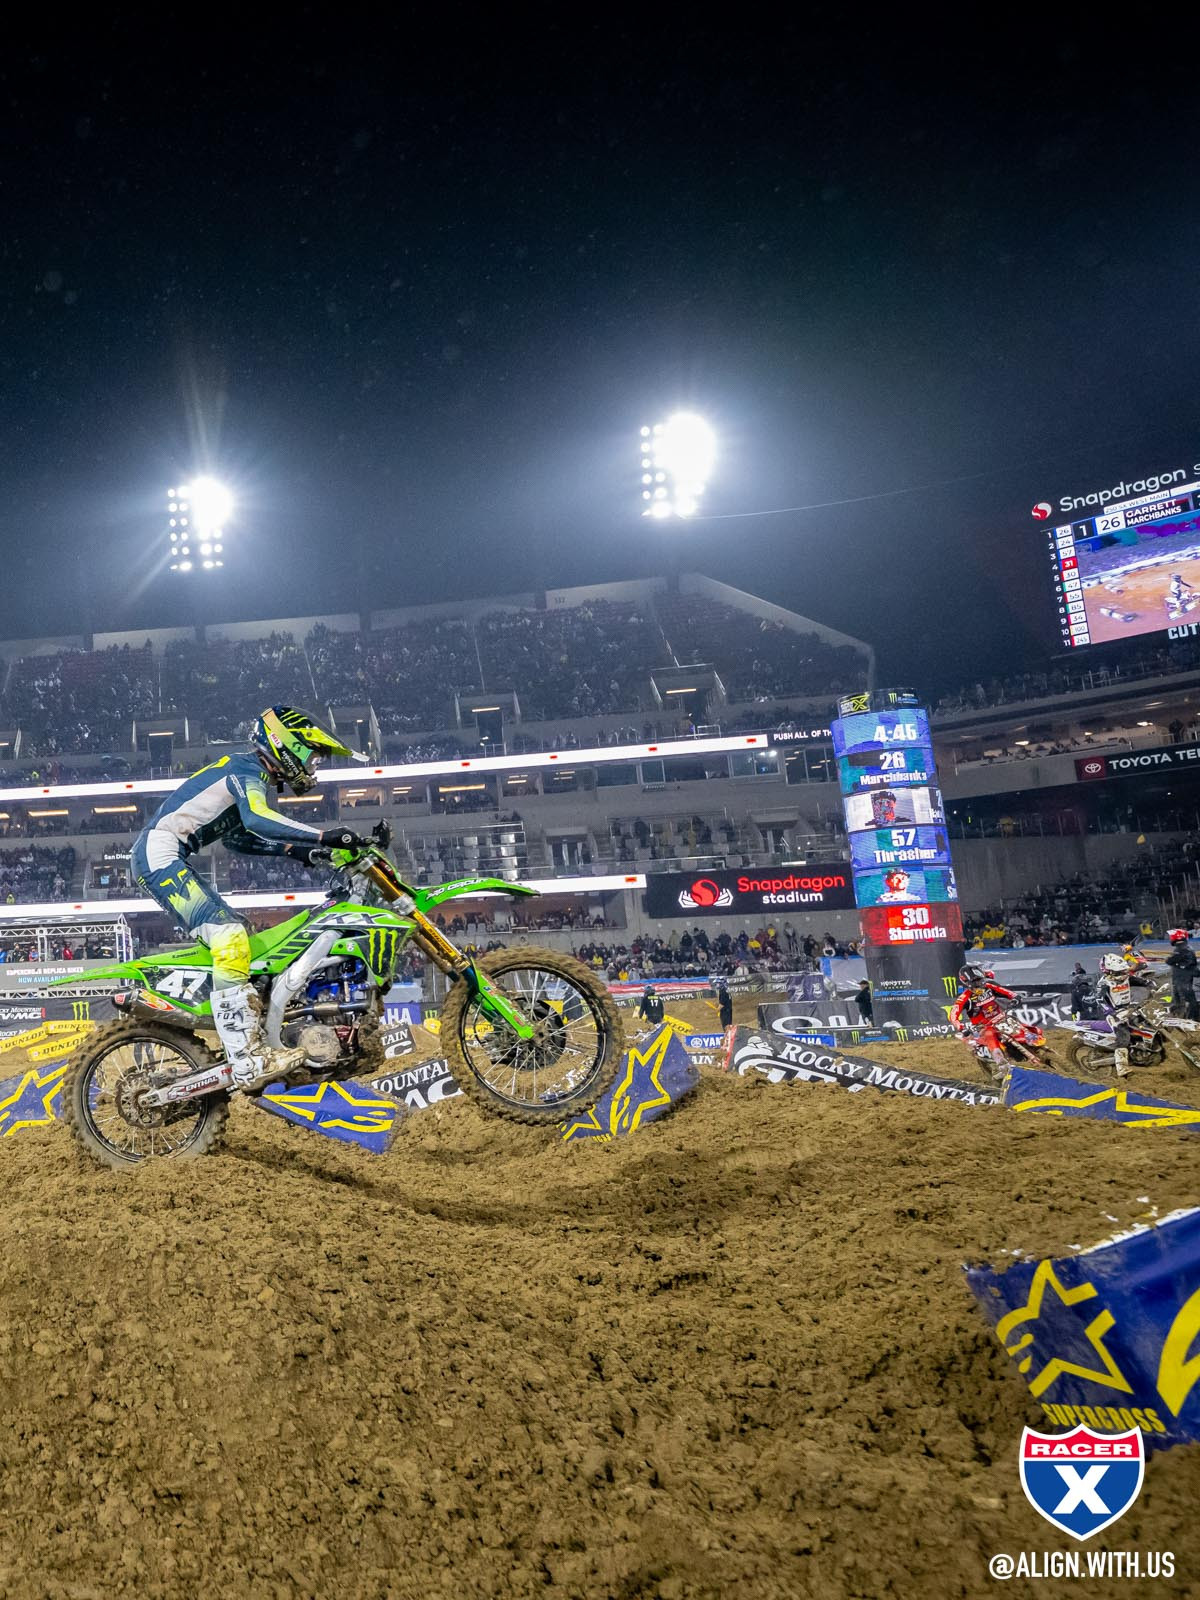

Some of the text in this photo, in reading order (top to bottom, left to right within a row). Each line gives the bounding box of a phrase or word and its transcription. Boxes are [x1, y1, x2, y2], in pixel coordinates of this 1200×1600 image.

[1060, 469, 1186, 512] Snapdragon
[1126, 500, 1176, 518] GARRETT
[1129, 498, 1148, 508] WEST
[1148, 492, 1169, 503] MAIN
[1127, 507, 1182, 526] MARCHBANKS
[1080, 517, 1121, 536] 1 26
[1065, 560, 1073, 568] 31
[1064, 639, 1071, 647] 11
[774, 732, 793, 741] PUSH
[794, 731, 809, 739] ALL
[880, 751, 906, 770] 26
[1109, 753, 1172, 770] TOYOTA
[891, 828, 916, 847] 57
[874, 846, 937, 863] Thrasher
[737, 875, 845, 894] Snapdragon
[763, 892, 823, 904] stadium
[902, 908, 929, 926] 30
[889, 926, 947, 941] Shimoda
[156, 970, 207, 1000] 47
[217, 1012, 236, 1020] FOX
[5, 1030, 46, 1048] DUNLOP
[778, 1042, 864, 1078] ROCKY
[1041, 1403, 1167, 1433] SUPERCROSS
